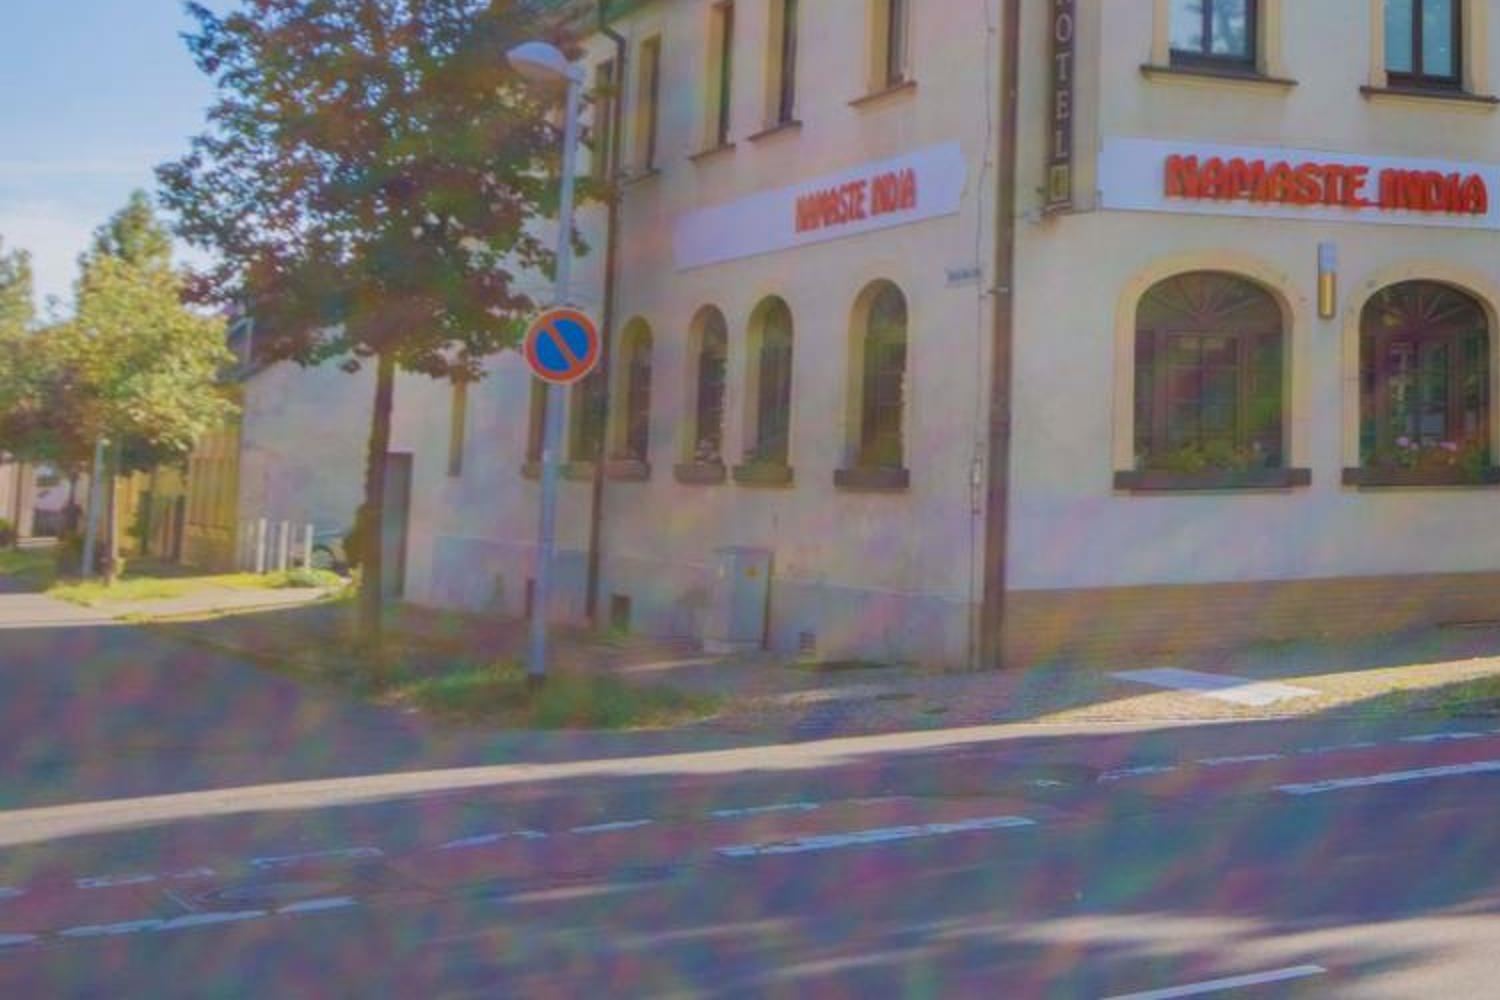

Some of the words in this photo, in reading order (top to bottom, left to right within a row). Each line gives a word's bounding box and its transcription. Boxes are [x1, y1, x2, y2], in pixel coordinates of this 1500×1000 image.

[870, 168, 917, 216] INDIA
[1165, 154, 1370, 207] NAMASTE
[1378, 168, 1488, 216] INDIA
